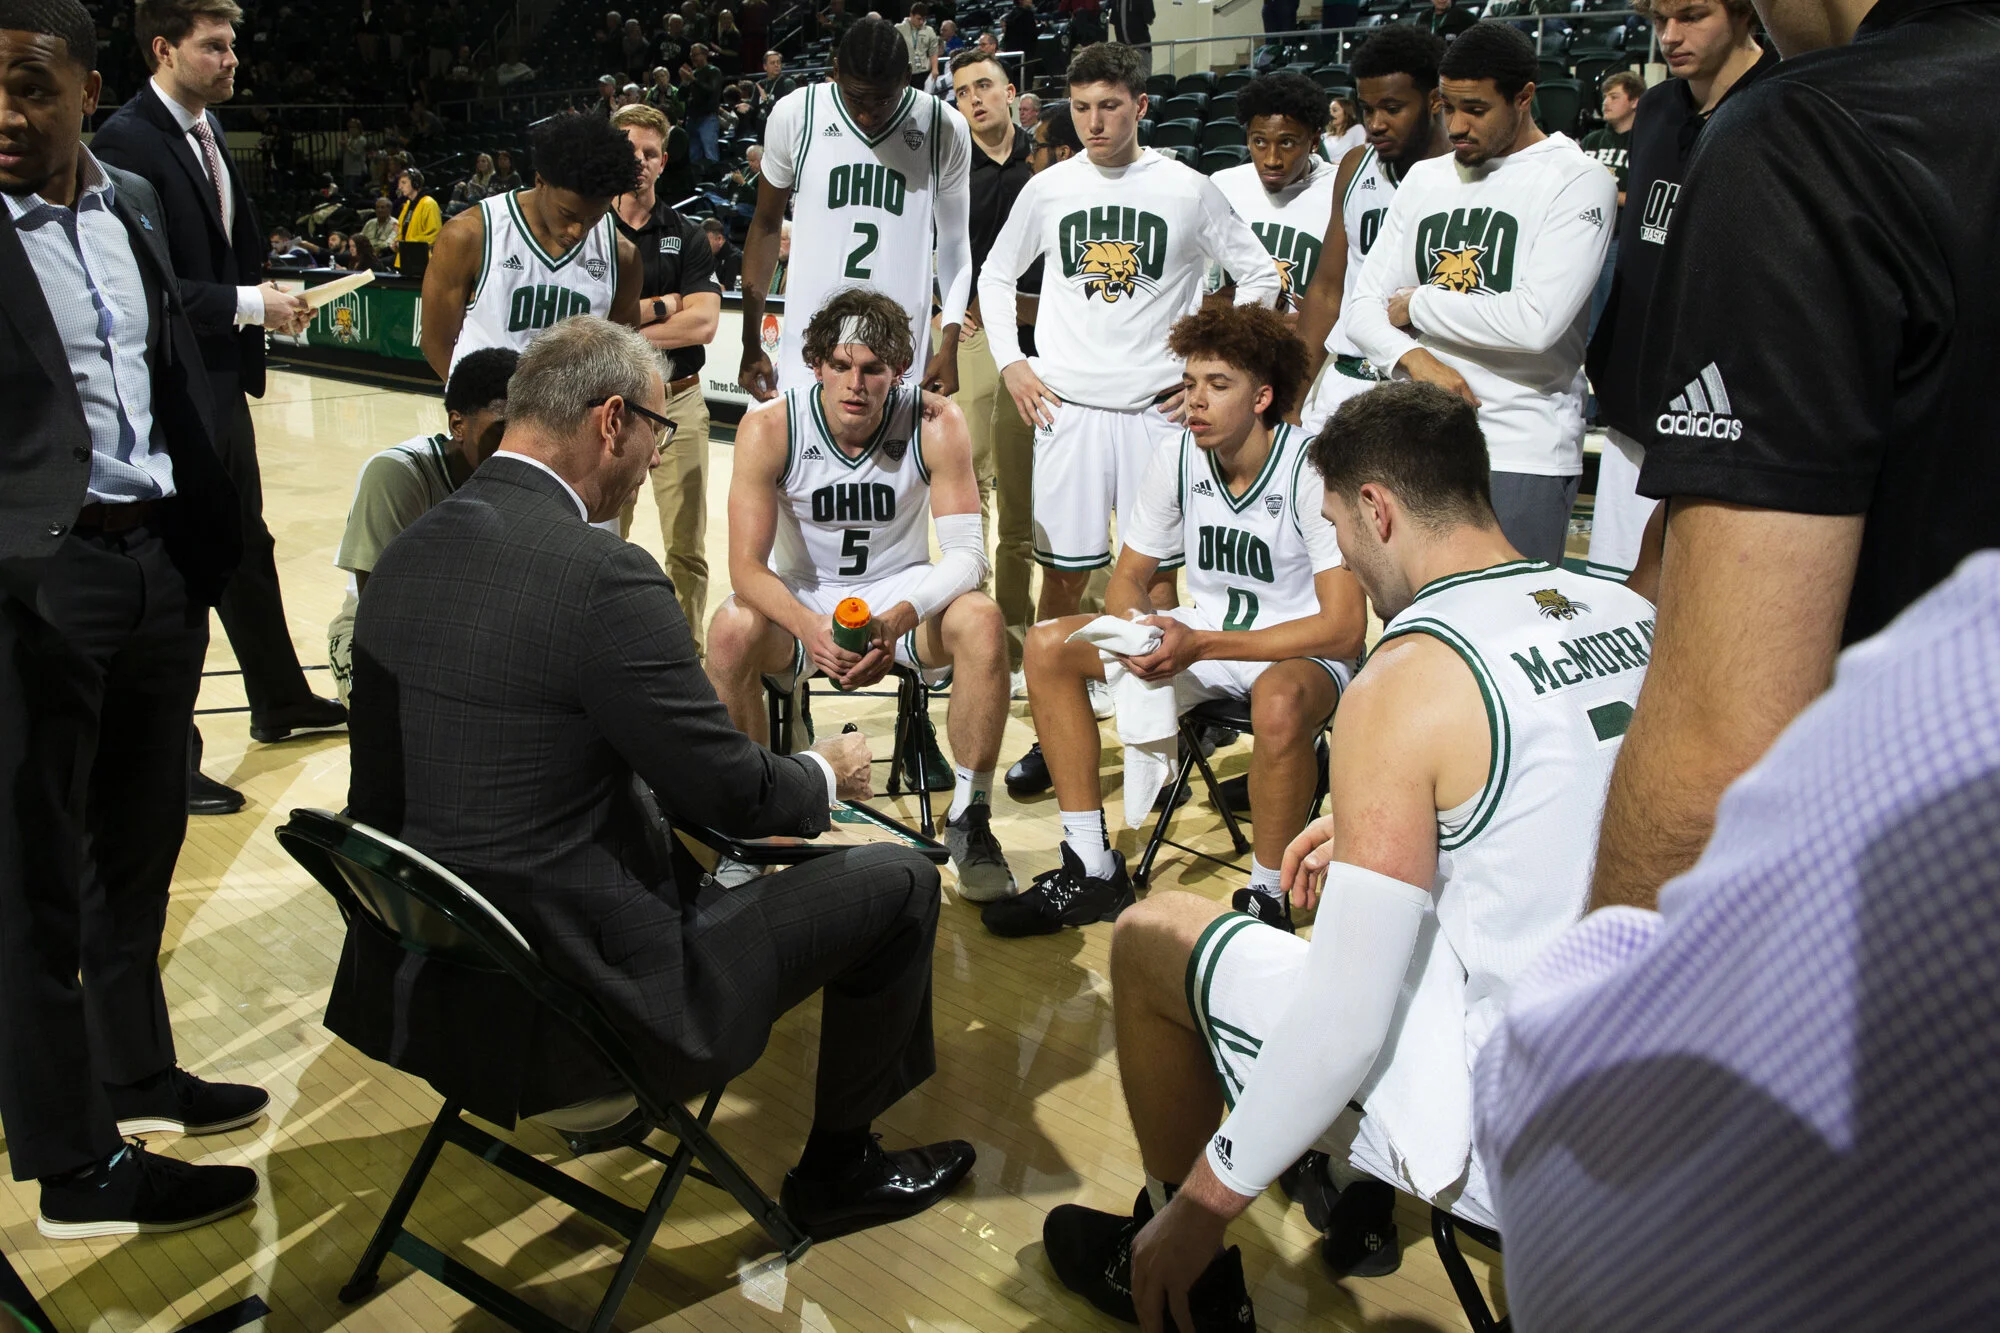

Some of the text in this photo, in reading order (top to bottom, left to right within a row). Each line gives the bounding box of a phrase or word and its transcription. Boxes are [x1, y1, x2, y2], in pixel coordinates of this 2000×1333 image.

[828, 163, 907, 217] OHIO
[844, 222, 879, 280] 2
[1059, 205, 1168, 281] OHIO
[1251, 222, 1323, 299] HIO
[709, 379, 728, 392] Three
[1656, 410, 1743, 441] adidas
[811, 482, 896, 522] OHIO
[838, 529, 871, 577] 5
[1198, 525, 1275, 584] OHIO
[1509, 620, 1656, 695] McMURR
